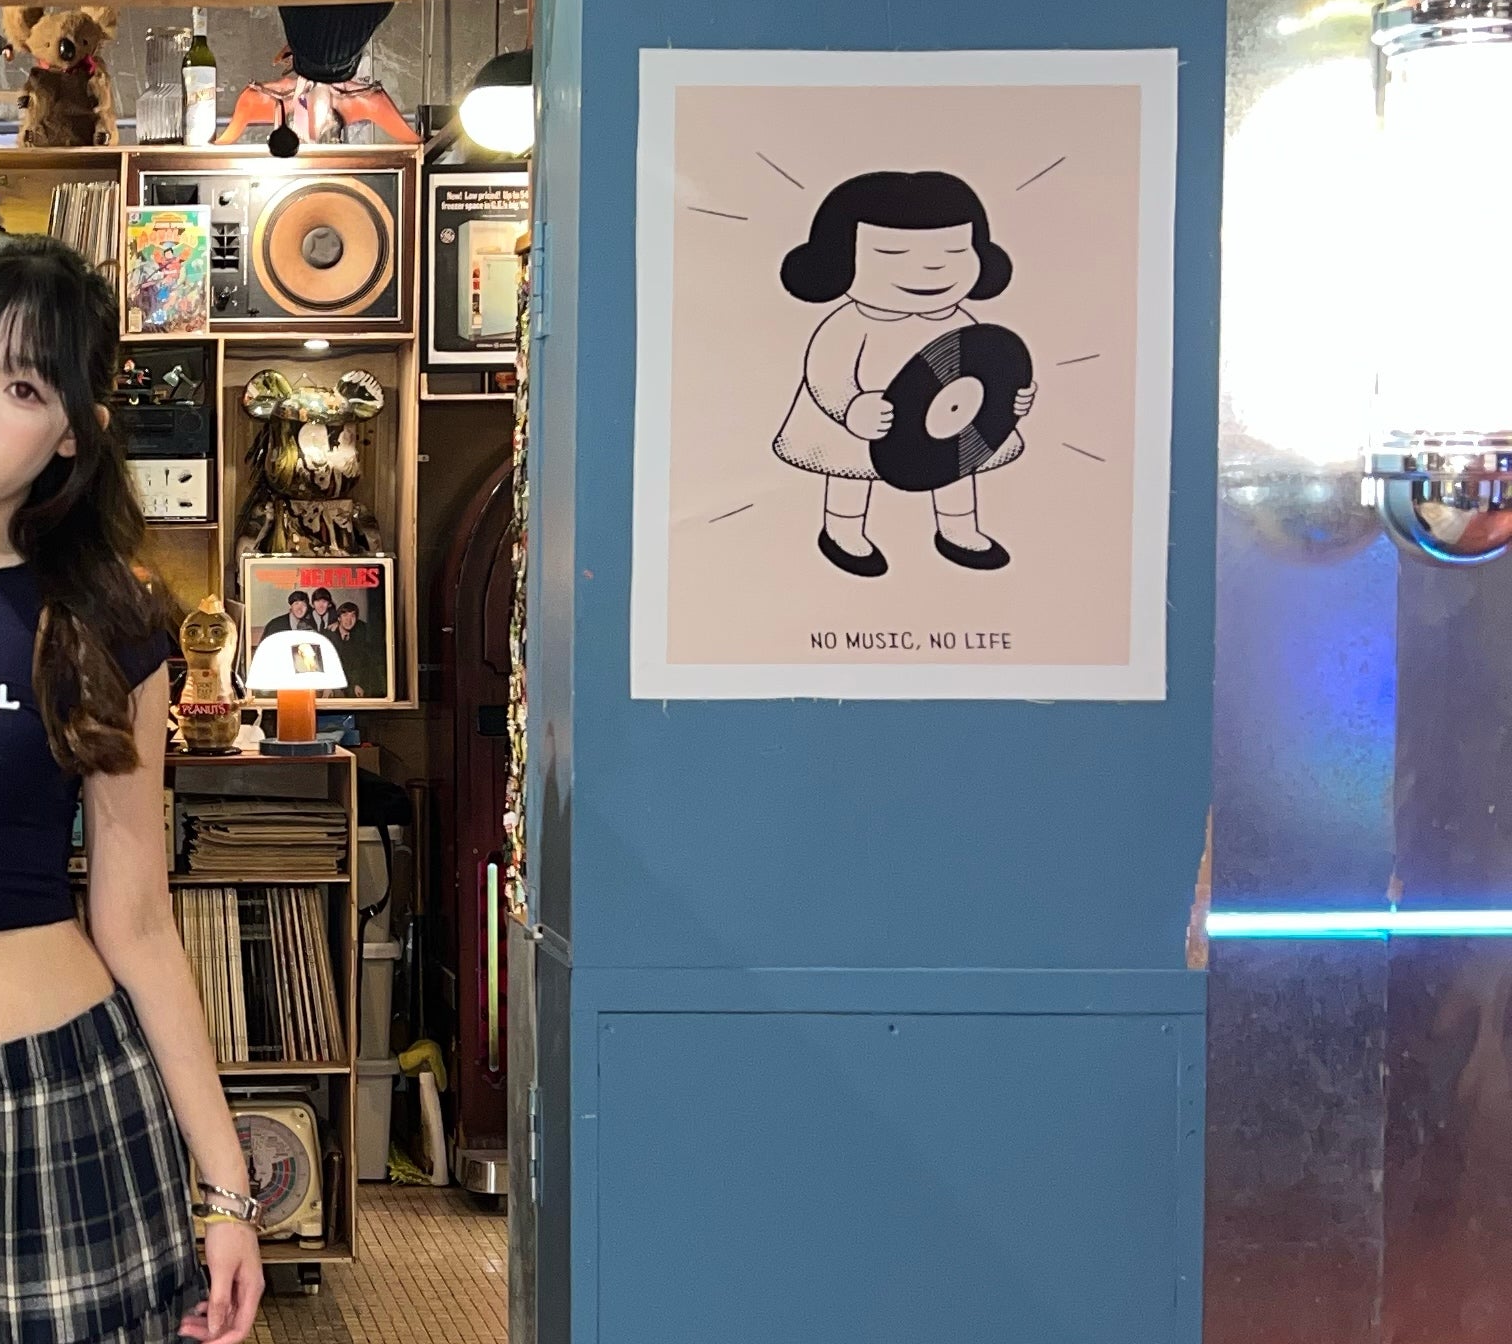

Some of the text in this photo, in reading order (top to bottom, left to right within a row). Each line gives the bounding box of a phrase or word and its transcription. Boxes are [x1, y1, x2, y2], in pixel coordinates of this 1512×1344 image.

[299, 567, 380, 588] BEATLES
[810, 631, 1012, 651] NO MUSIC, NO LIFE
[181, 703, 226, 715] PEANUTS
